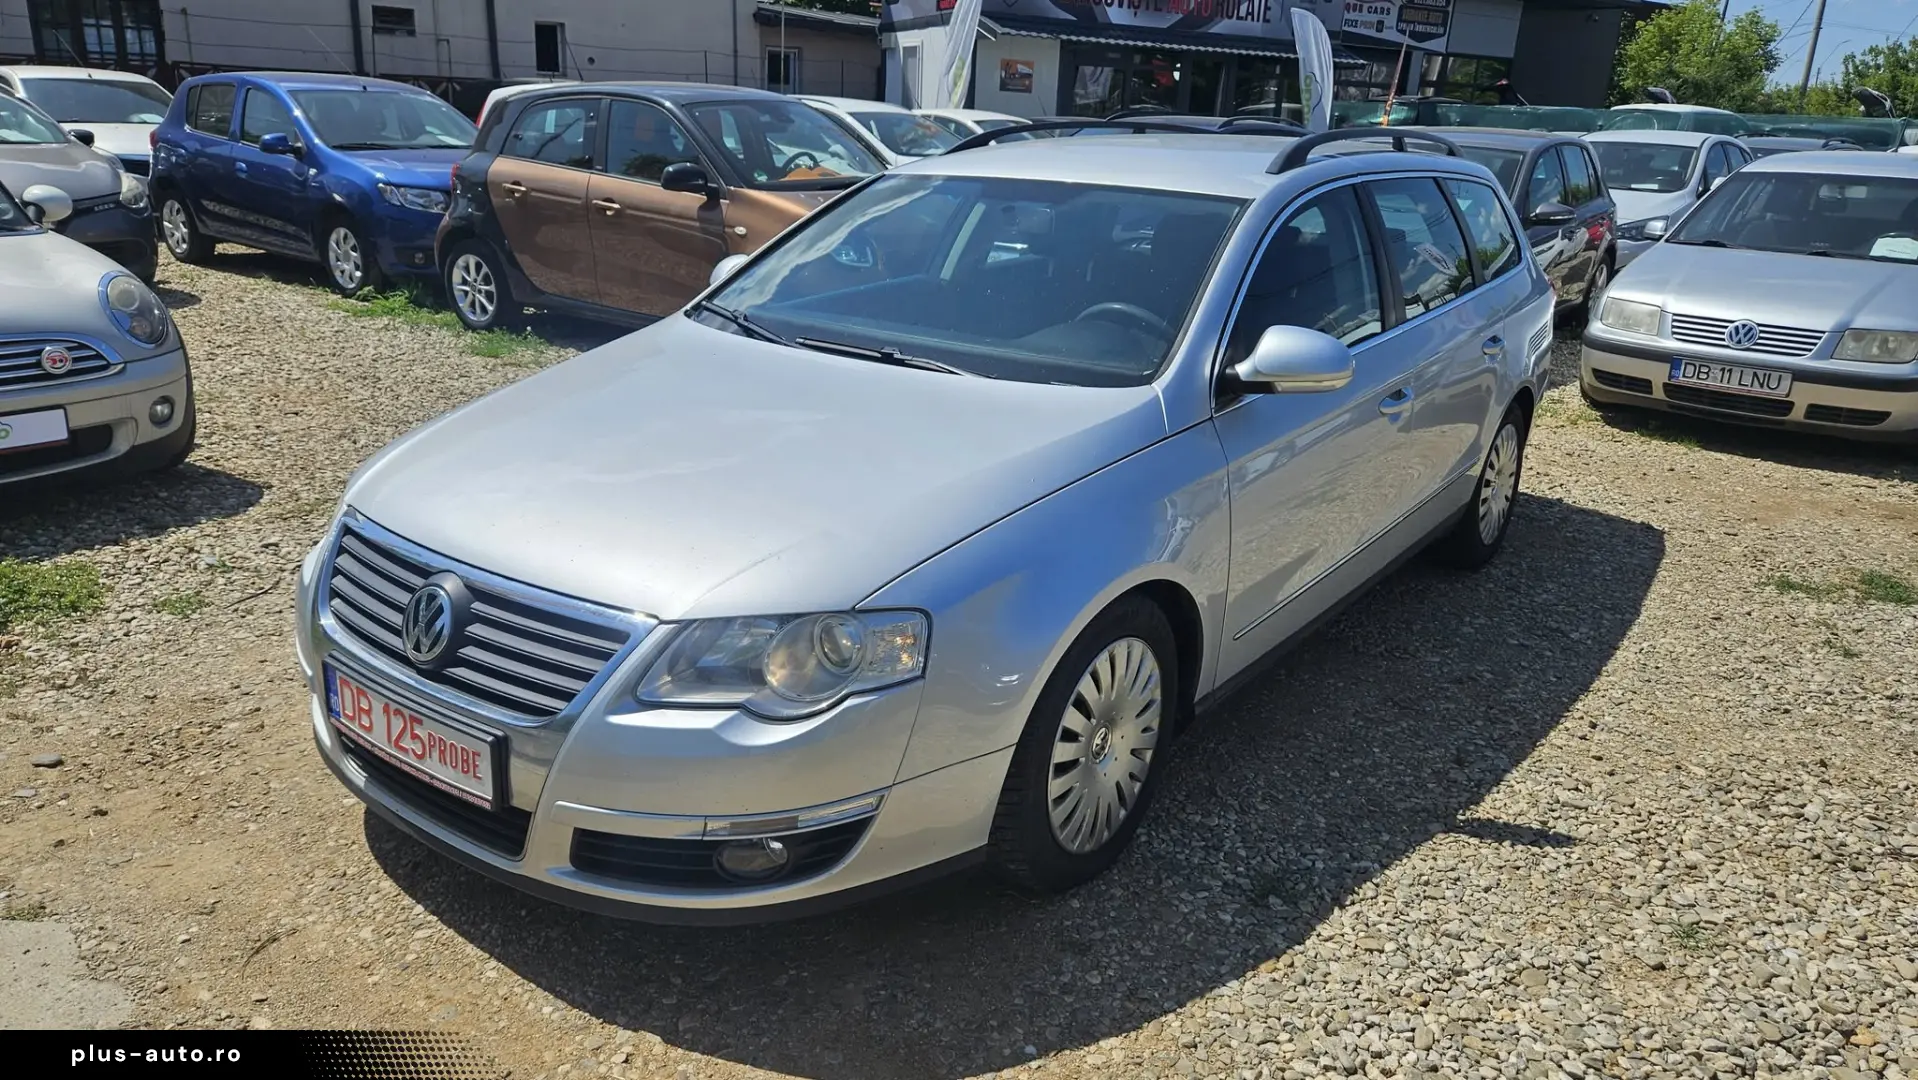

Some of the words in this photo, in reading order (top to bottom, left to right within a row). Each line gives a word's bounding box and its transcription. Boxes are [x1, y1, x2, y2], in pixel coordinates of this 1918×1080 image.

[1367, 5, 1392, 16] CARS
[1343, 18, 1359, 29] FIXE
[1682, 362, 1711, 380] DB
[1719, 367, 1733, 384] 11
[1738, 370, 1783, 390] LNU
[339, 676, 373, 732] DB
